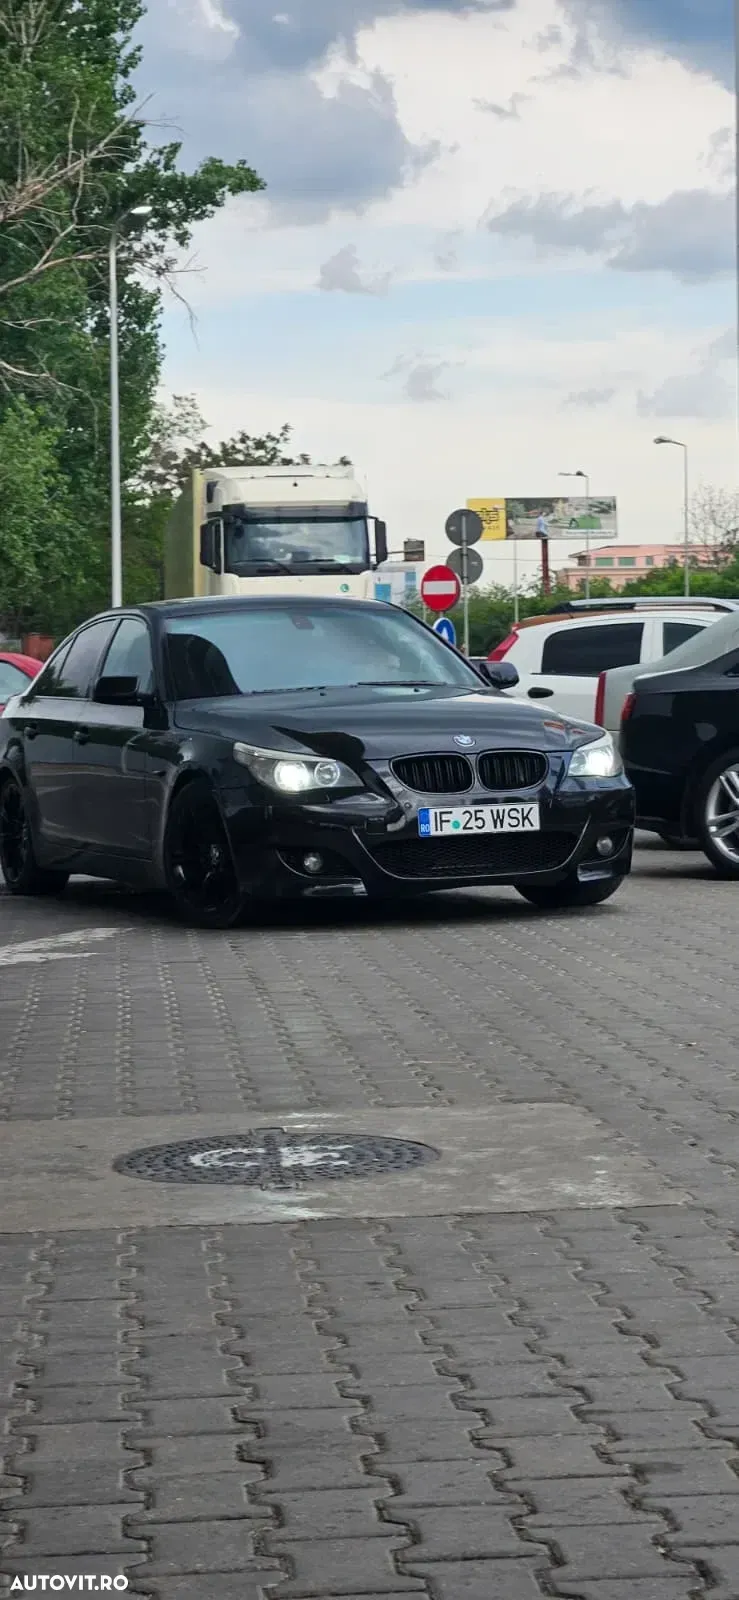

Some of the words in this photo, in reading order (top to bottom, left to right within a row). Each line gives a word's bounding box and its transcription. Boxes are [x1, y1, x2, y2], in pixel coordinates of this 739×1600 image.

[434, 811, 453, 832] IF
[462, 809, 486, 830] 25
[490, 807, 535, 829] WSK
[420, 824, 430, 833] RO
